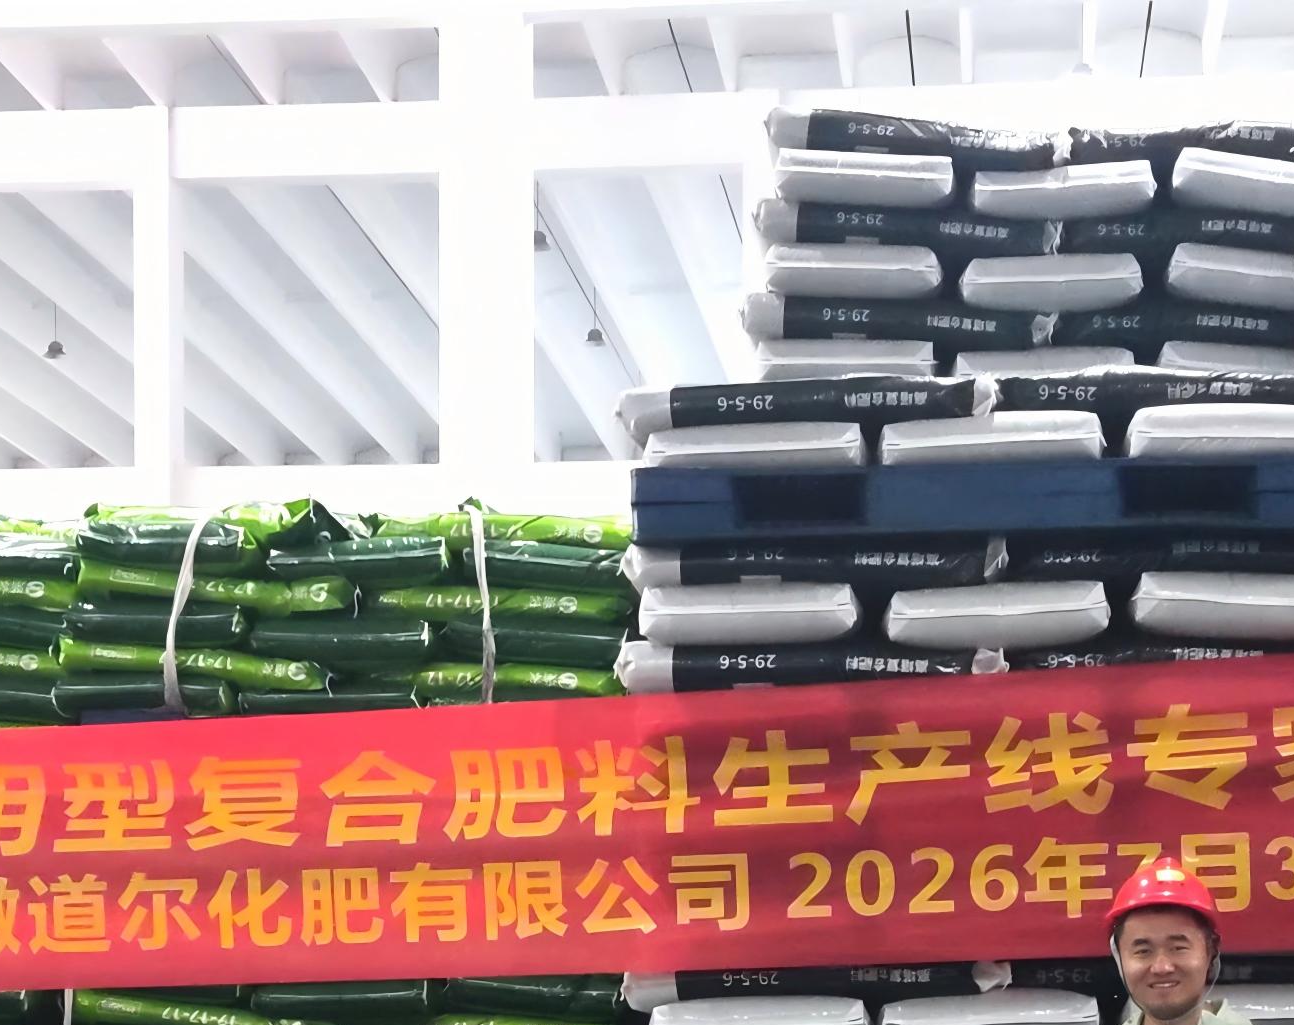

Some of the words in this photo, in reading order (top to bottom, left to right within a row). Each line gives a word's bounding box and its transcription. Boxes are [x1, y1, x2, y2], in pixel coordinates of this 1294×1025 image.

[848, 122, 894, 136] 29-5-6
[836, 210, 884, 224] 29-5-6
[1096, 222, 1144, 236] 29-5-6
[822, 308, 870, 322] 29-5-6
[1038, 384, 1096, 402] 29-5-6
[716, 392, 774, 412] 29-5-6
[718, 654, 776, 670] 29-5-6
[722, 970, 780, 986] 29-5-6
